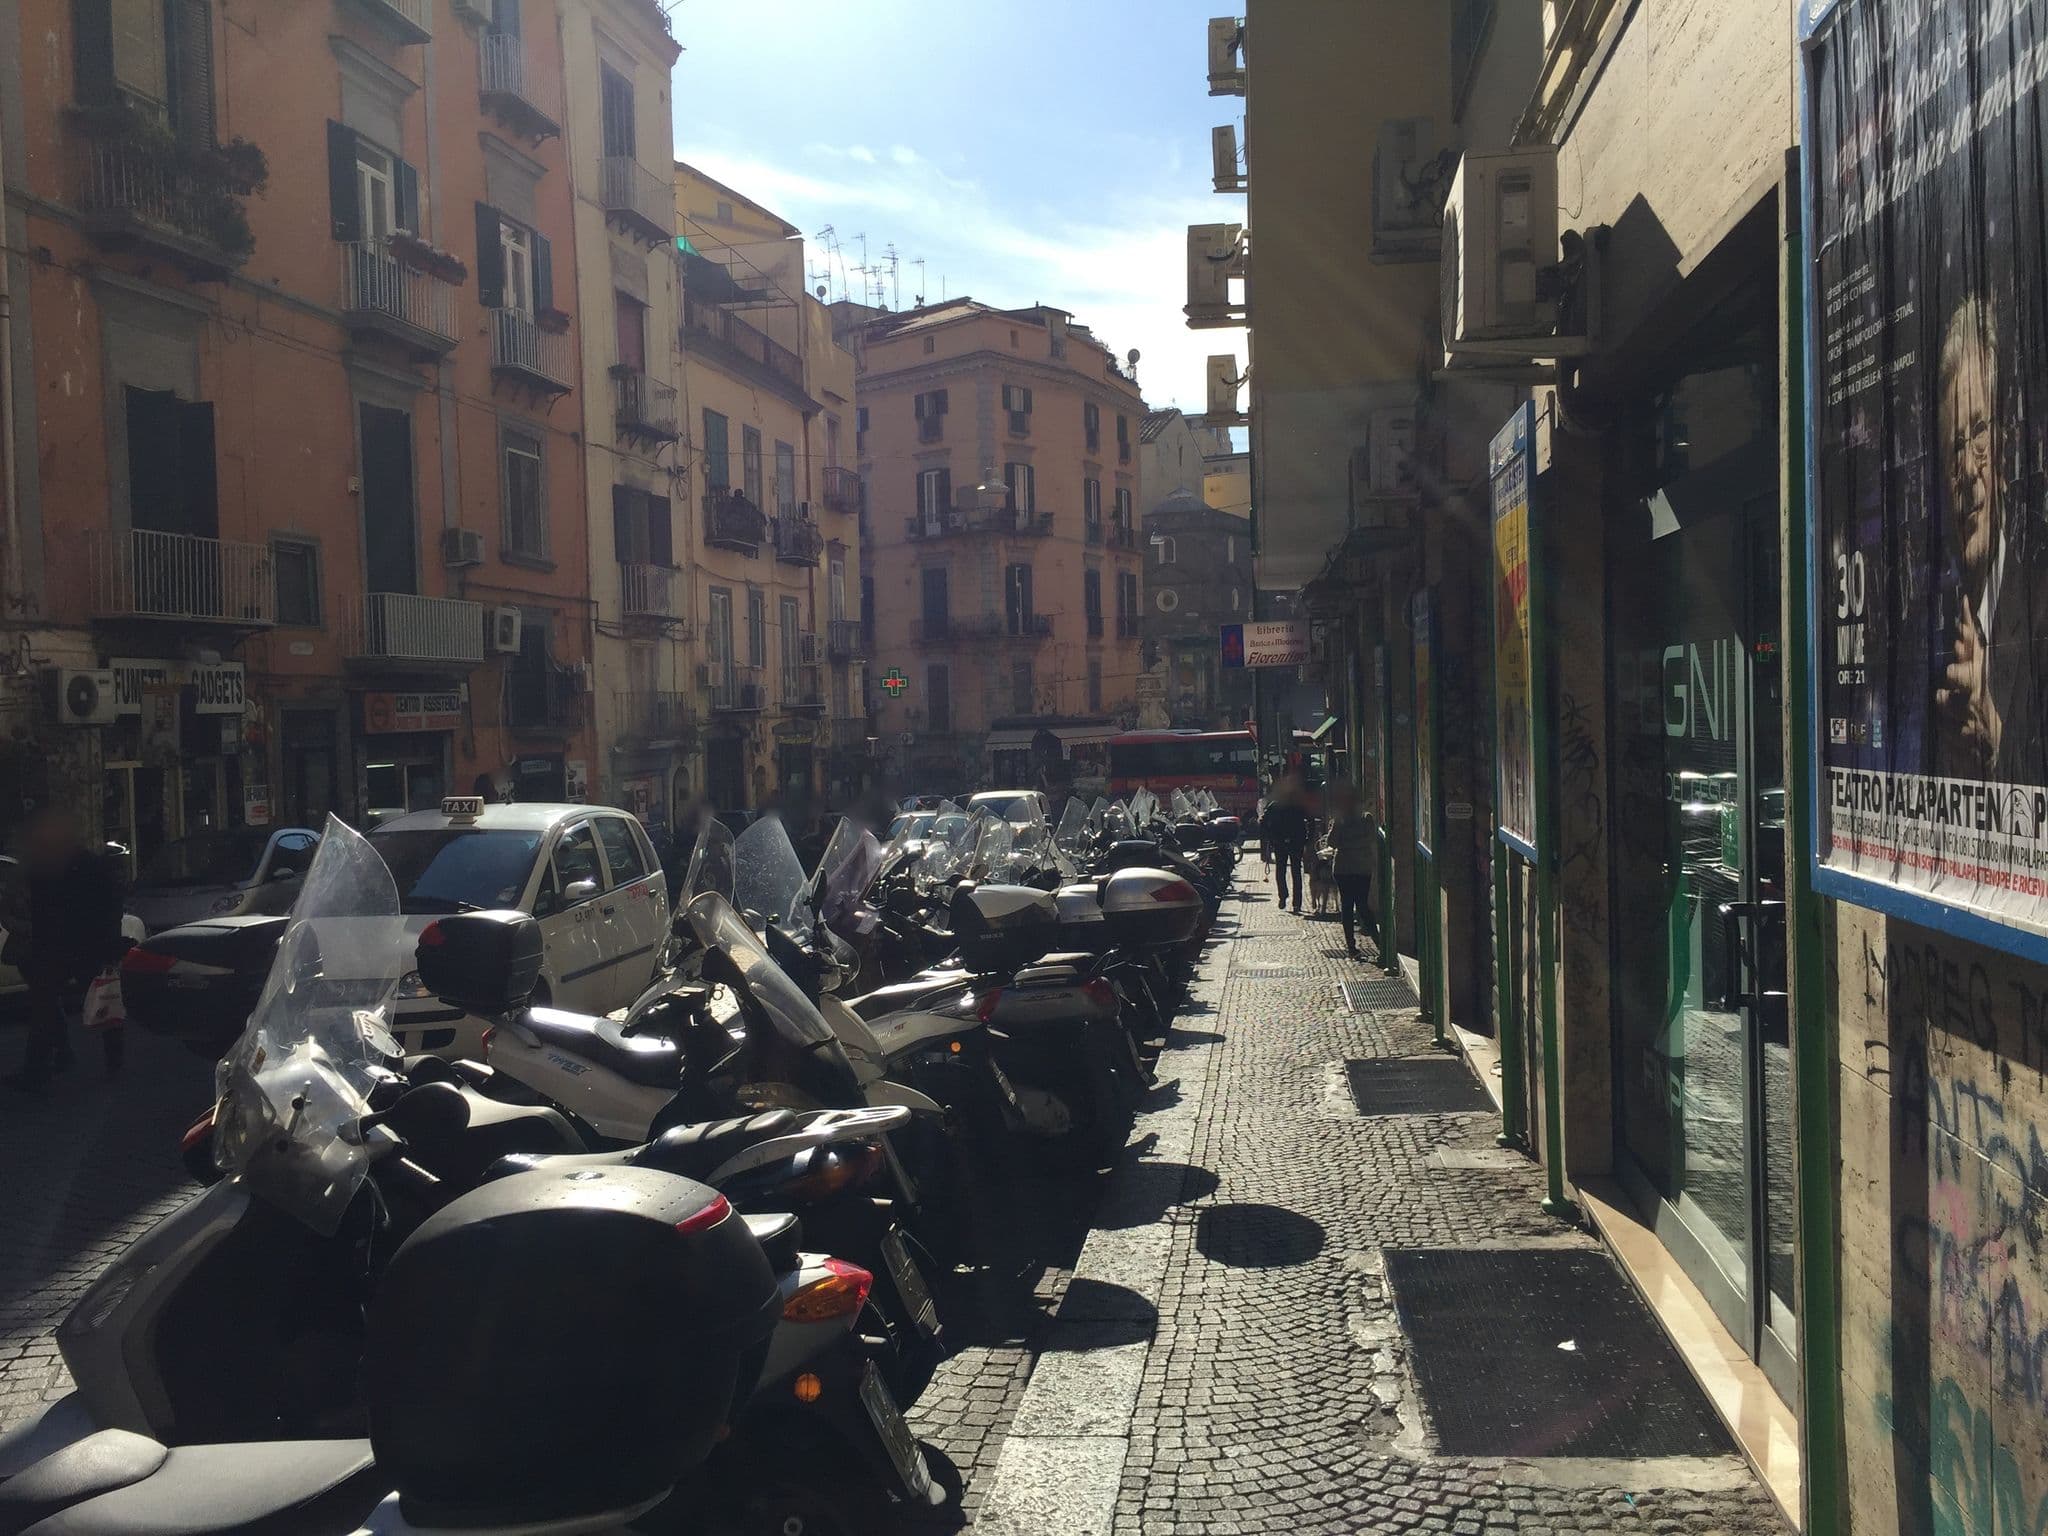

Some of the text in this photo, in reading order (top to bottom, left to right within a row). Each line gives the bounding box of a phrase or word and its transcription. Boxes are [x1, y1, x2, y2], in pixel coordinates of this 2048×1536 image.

[1837, 550, 1865, 620] 30
[191, 669, 243, 705] GADGETS
[1854, 669, 1865, 685] 21
[443, 801, 476, 813] TAXI
[1826, 769, 1882, 814] TEATRO
